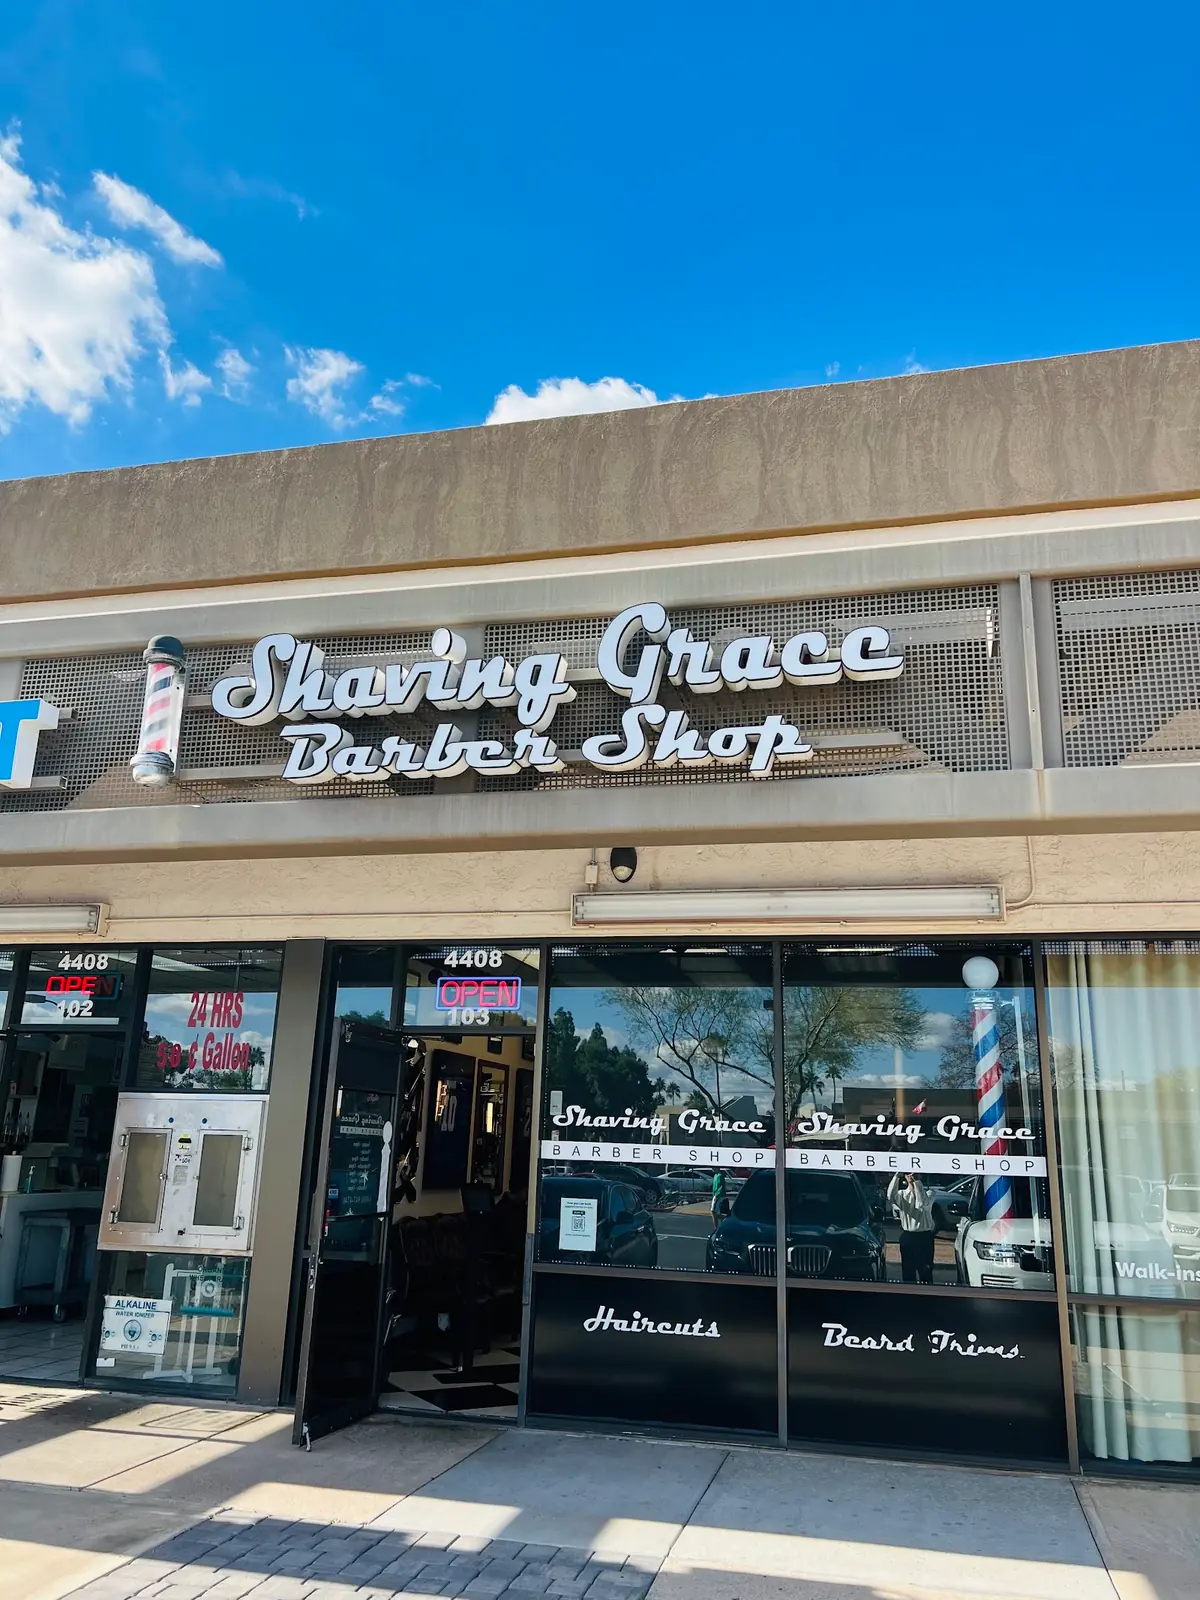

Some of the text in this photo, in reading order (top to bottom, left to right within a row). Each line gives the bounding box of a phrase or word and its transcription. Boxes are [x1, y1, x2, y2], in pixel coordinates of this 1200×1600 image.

[211, 600, 904, 727] Shaving Grace
[279, 704, 813, 781] Barber Shop
[58, 953, 109, 971] 4408
[443, 950, 503, 968] 4408
[440, 980, 518, 1007] OPEN
[56, 1000, 94, 1017] 102
[187, 991, 244, 1029] 24 HRS
[447, 1007, 491, 1026] 103
[202, 1032, 250, 1070] Gallon
[552, 1105, 767, 1136] Shaving Grace
[797, 1112, 1036, 1144] Shaving Grace
[552, 1145, 764, 1164] BARBER SHOP
[800, 1153, 1035, 1172] BARBER SHOP
[115, 1299, 157, 1310] ALKALINE
[583, 1305, 721, 1338] Haircuts
[821, 1322, 1021, 1359] Beard Trims
